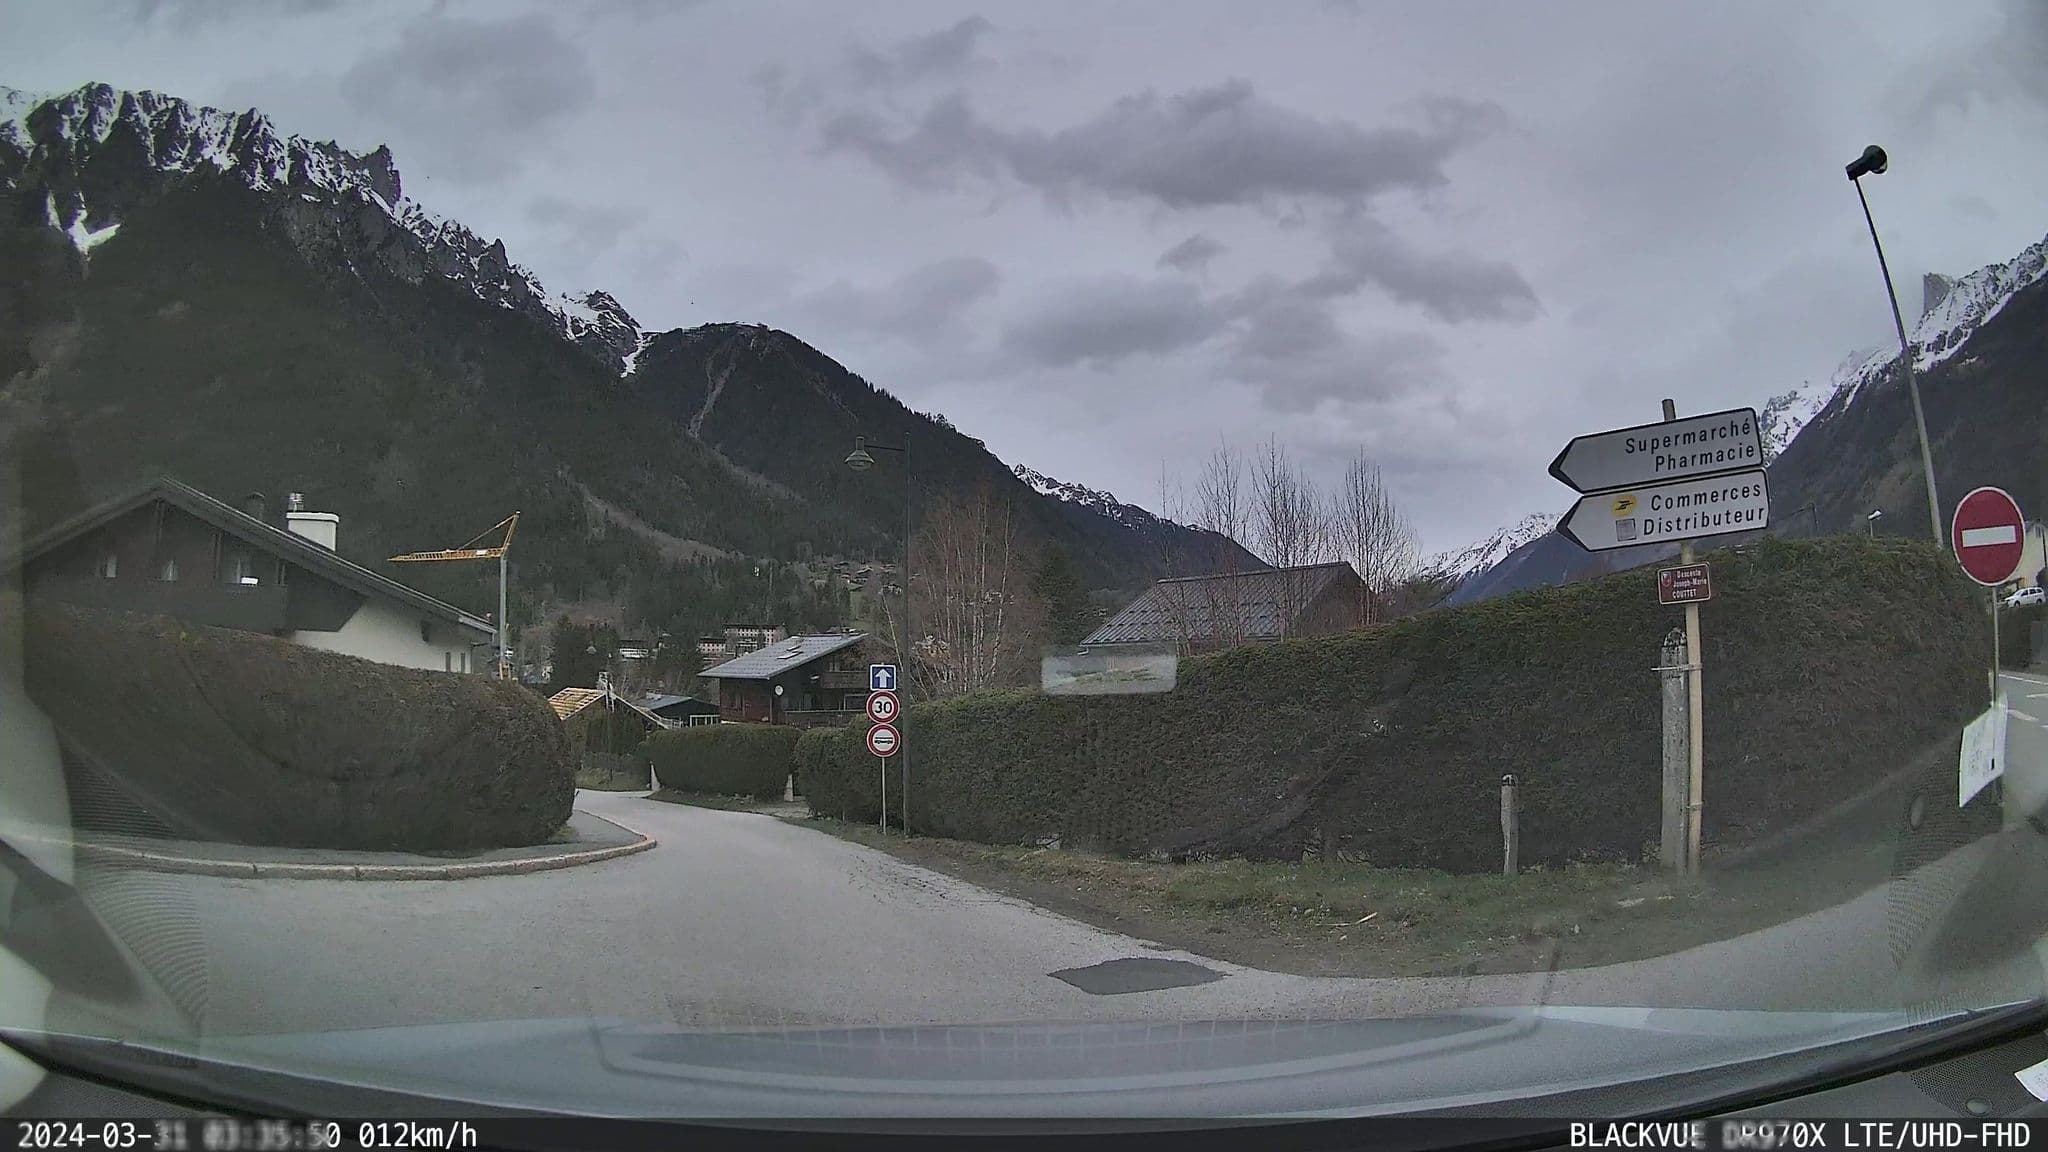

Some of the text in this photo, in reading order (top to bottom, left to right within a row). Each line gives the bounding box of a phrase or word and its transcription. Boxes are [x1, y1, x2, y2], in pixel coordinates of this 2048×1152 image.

[1625, 418, 1751, 454] Supermarché
[1655, 443, 1755, 472] Pharmacie
[1651, 484, 1761, 511] Commerces
[1643, 507, 1765, 536] Distributeur
[1672, 588, 1697, 599] COUTTET
[874, 701, 893, 714] 30
